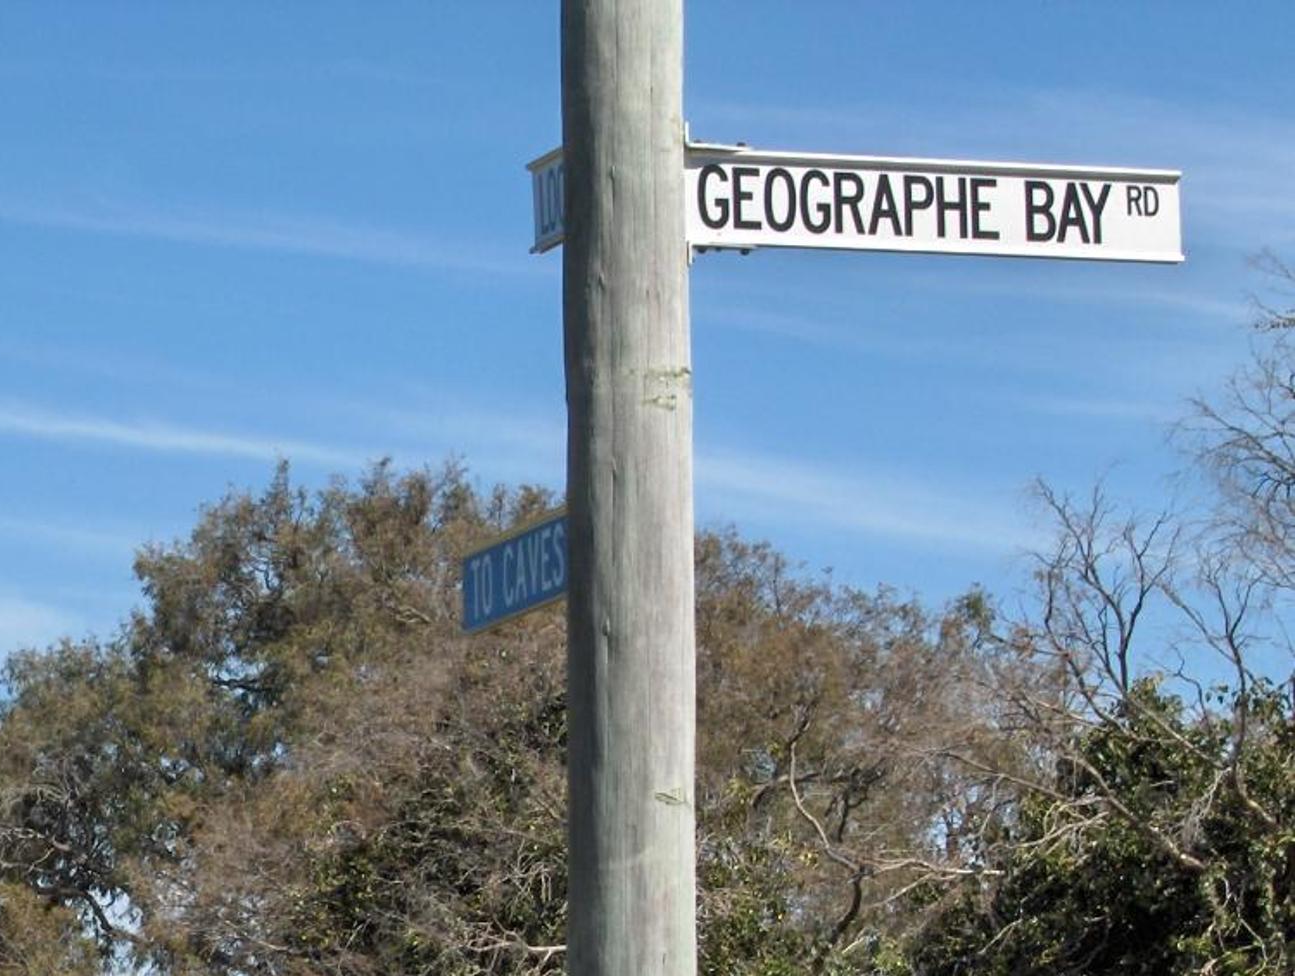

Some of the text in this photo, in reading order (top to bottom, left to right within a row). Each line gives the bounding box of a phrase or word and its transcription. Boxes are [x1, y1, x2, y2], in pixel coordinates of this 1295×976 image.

[698, 163, 1160, 244] GEOGRAPHE BAY RD
[471, 522, 564, 620] TO CAVES
